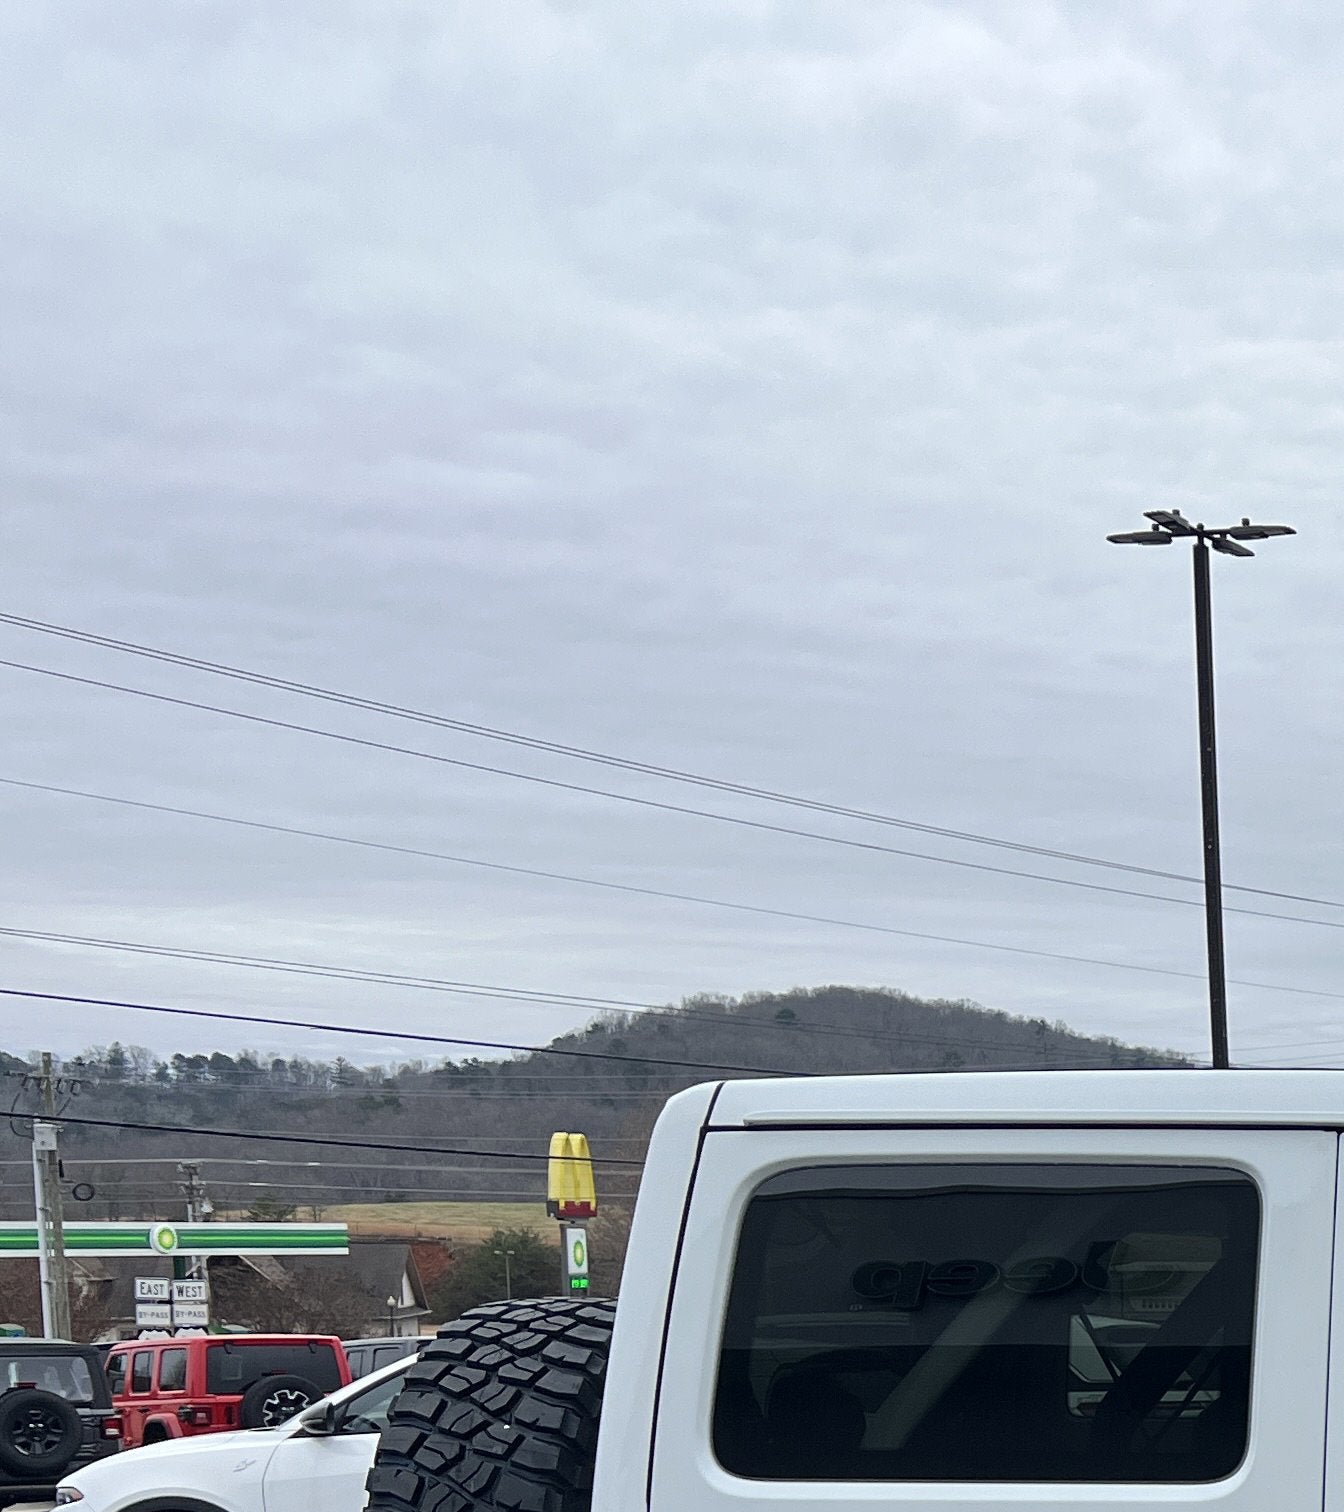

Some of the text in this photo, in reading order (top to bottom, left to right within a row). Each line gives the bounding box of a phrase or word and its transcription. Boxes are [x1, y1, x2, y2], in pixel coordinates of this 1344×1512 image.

[140, 1282, 164, 1296] EAST
[176, 1285, 202, 1298] WEST
[138, 1311, 169, 1319] BY-PASS
[175, 1310, 206, 1318] BY-PASS
